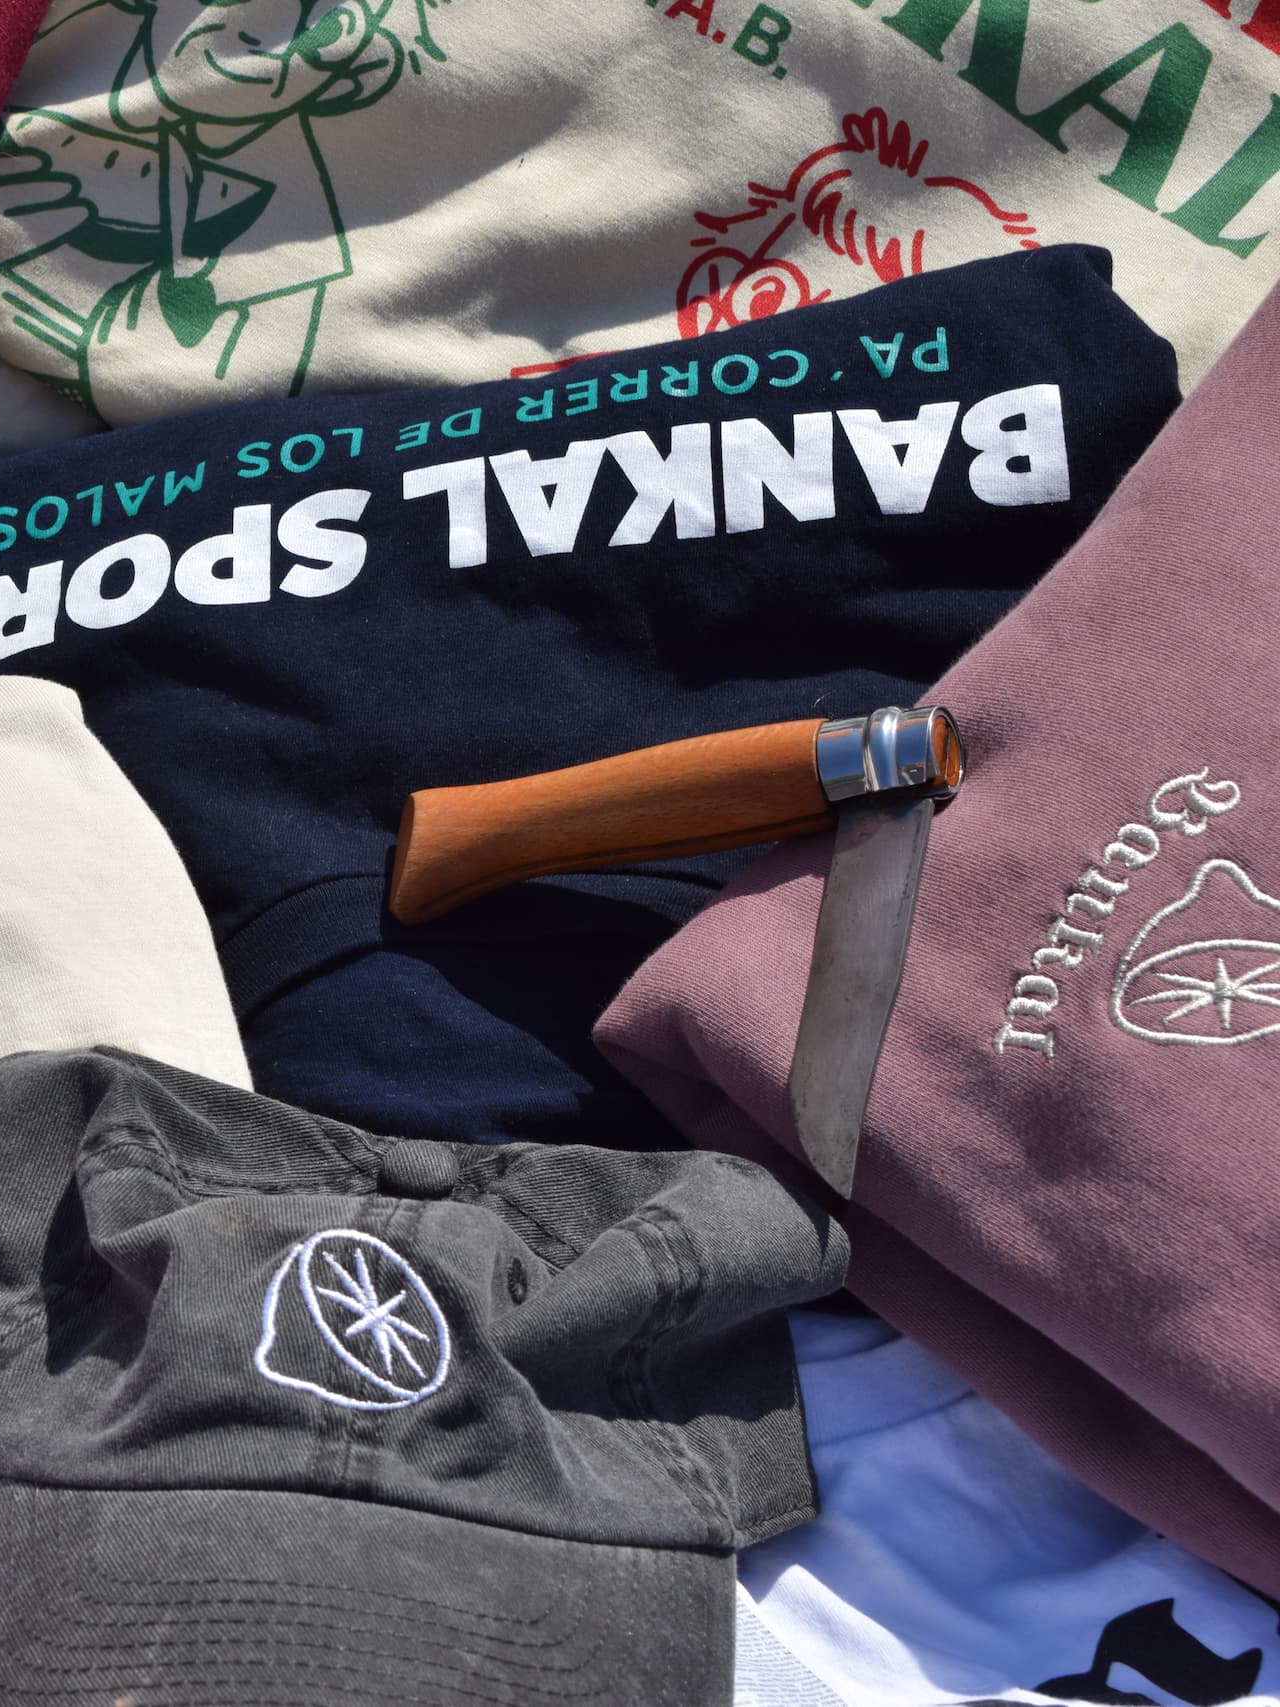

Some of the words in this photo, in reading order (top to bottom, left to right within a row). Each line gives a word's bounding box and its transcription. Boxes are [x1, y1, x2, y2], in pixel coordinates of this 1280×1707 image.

[515, 348, 810, 423] CORRER
[236, 427, 364, 479] LOS
[394, 407, 483, 452] DE
[402, 383, 1071, 569] BANKAL
[993, 765, 1241, 1058] Bankal
